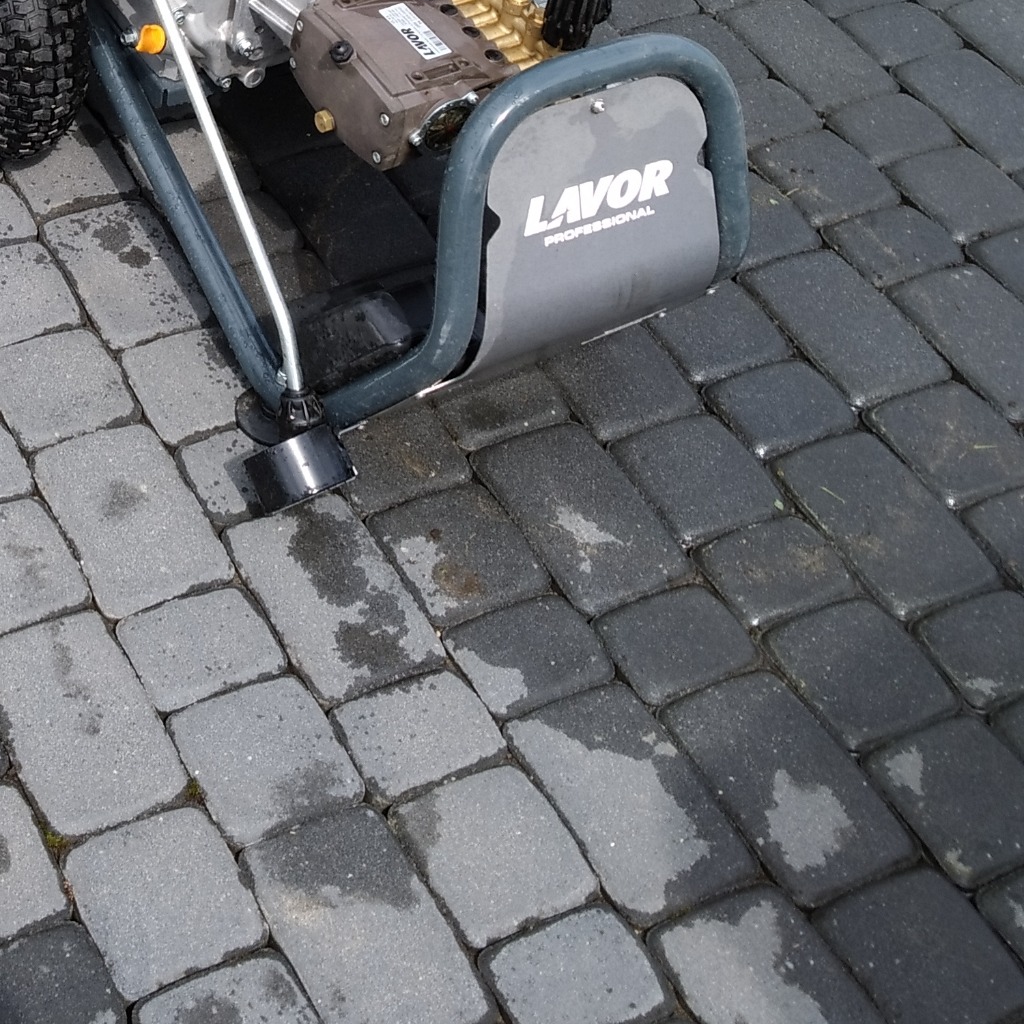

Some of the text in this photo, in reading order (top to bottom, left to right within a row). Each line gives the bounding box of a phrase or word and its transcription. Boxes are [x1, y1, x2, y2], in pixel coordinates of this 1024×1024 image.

[401, 28, 435, 55] LAVOR
[524, 159, 674, 237] LAVOR
[544, 205, 655, 247] PROFESSIONAL
